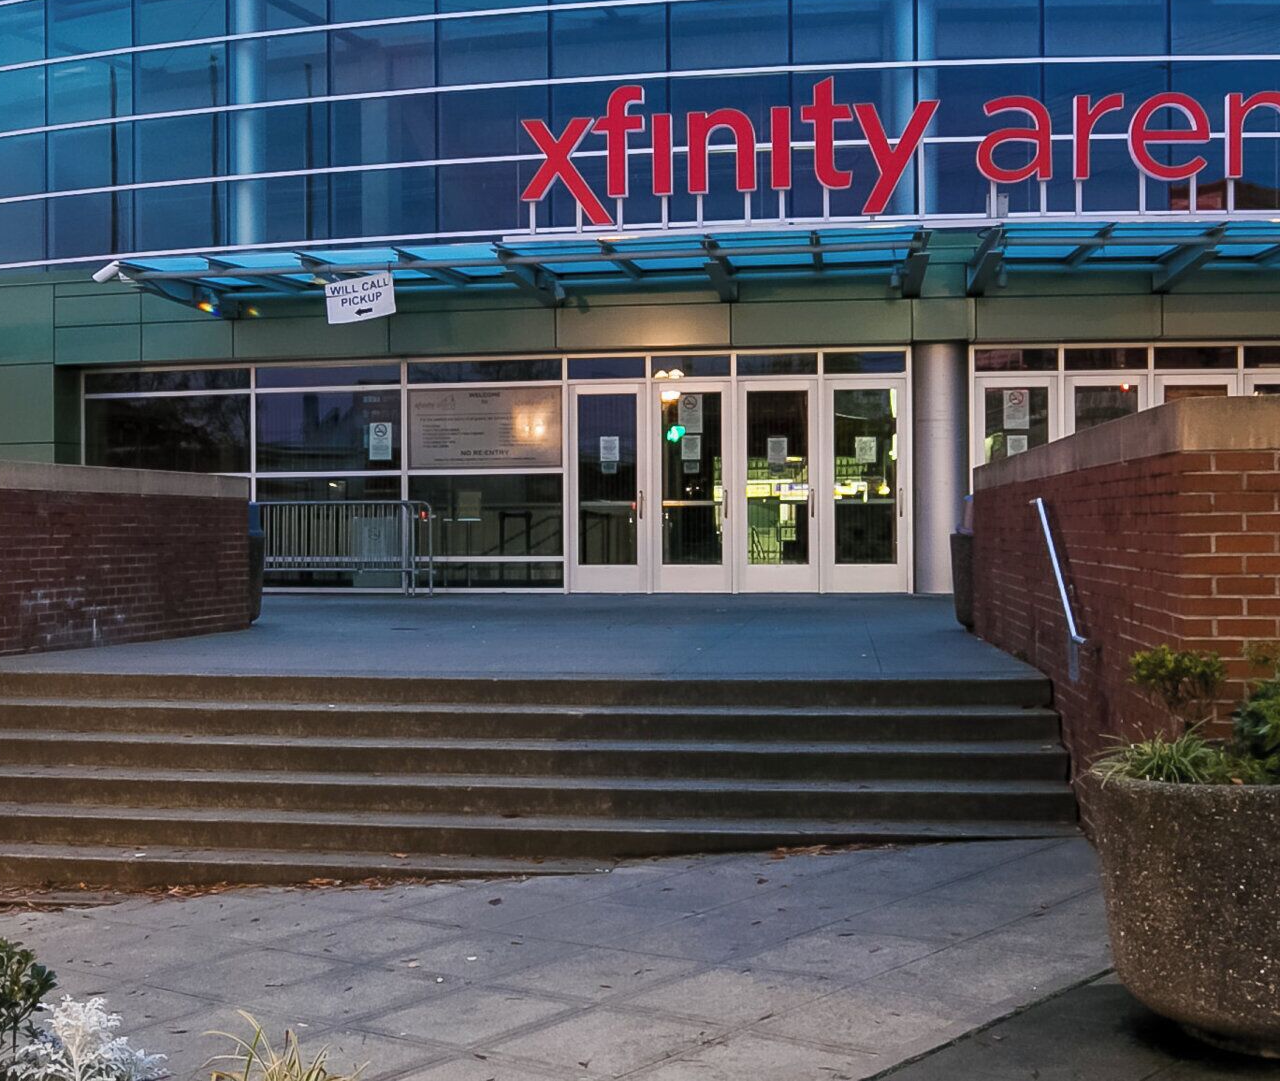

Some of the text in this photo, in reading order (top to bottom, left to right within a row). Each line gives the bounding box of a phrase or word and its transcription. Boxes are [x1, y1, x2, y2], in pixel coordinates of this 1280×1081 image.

[520, 76, 941, 226] xfinity
[330, 278, 389, 295] WILL CALL
[341, 291, 382, 307] PICKUP
